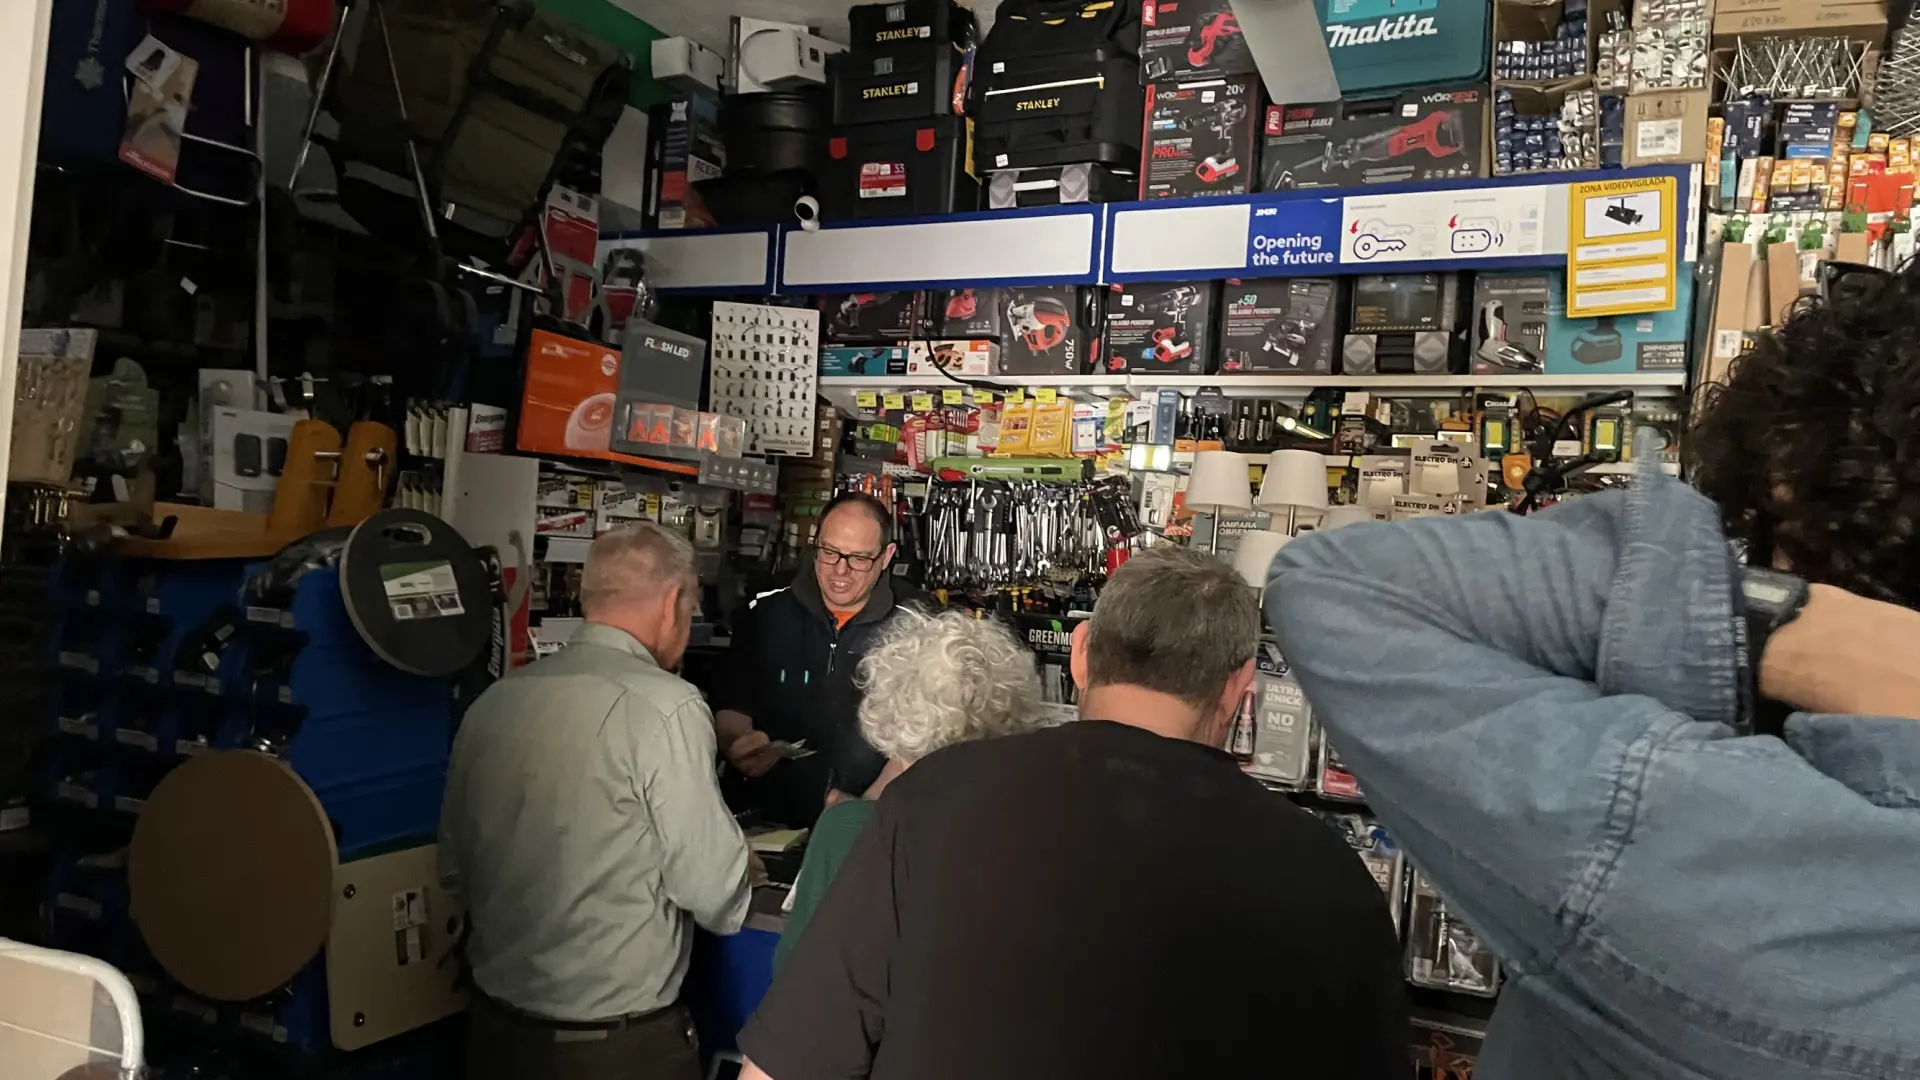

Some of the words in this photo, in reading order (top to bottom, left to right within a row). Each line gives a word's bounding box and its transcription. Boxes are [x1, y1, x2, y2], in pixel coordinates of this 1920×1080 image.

[876, 27, 920, 42] STANLEY
[863, 84, 908, 99] STANLEY
[1016, 98, 1060, 111] STANLEY
[1269, 111, 1279, 130] PRO
[1152, 146, 1175, 158] PRO
[1579, 184, 1602, 194] ZONA
[1604, 176, 1667, 191] VIDEOVIGILADA
[1253, 232, 1322, 251] Opening
[1252, 251, 1281, 266] the
[1283, 249, 1334, 265] future
[1065, 339, 1074, 370] 750W
[1414, 455, 1445, 464] ELECTRO
[1395, 501, 1427, 510] ELECTRO
[1219, 521, 1257, 529] AMPARA
[1260, 661, 1287, 673] CES
[1265, 683, 1302, 697] ULTRA
[1267, 711, 1295, 726] NO
